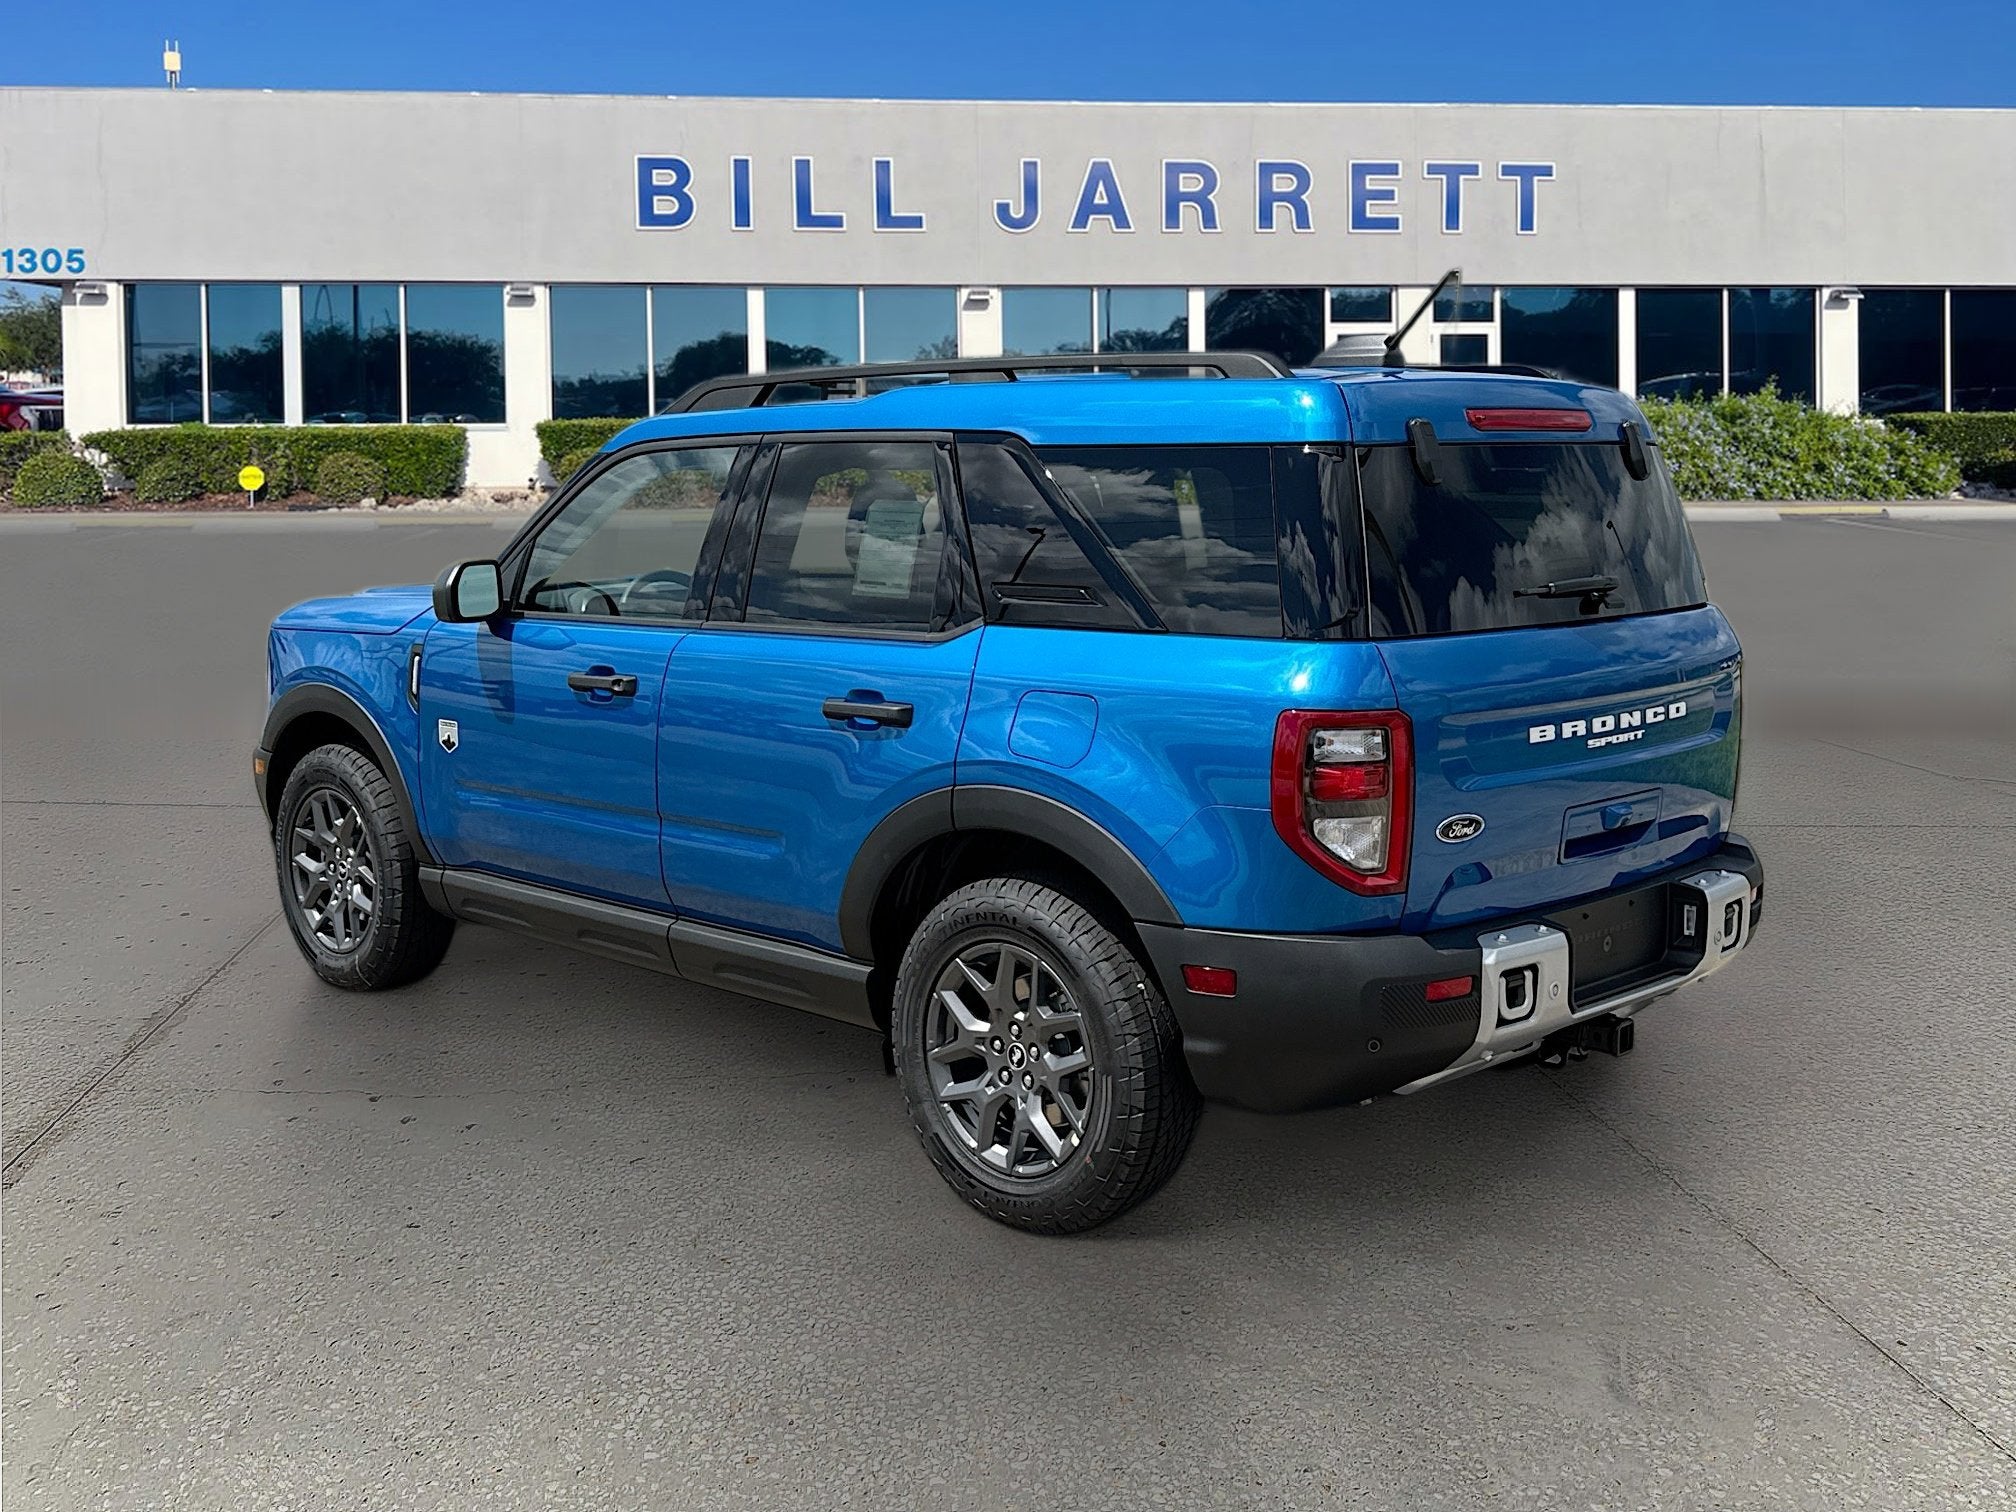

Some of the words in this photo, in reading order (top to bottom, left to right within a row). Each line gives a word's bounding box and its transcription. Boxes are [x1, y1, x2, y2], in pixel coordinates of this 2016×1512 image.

[634, 155, 927, 232] BILL
[993, 158, 1556, 235] JARRETT
[1, 248, 86, 274] 1305
[1528, 701, 1688, 744] BRONCO
[1586, 729, 1646, 749] SPORT
